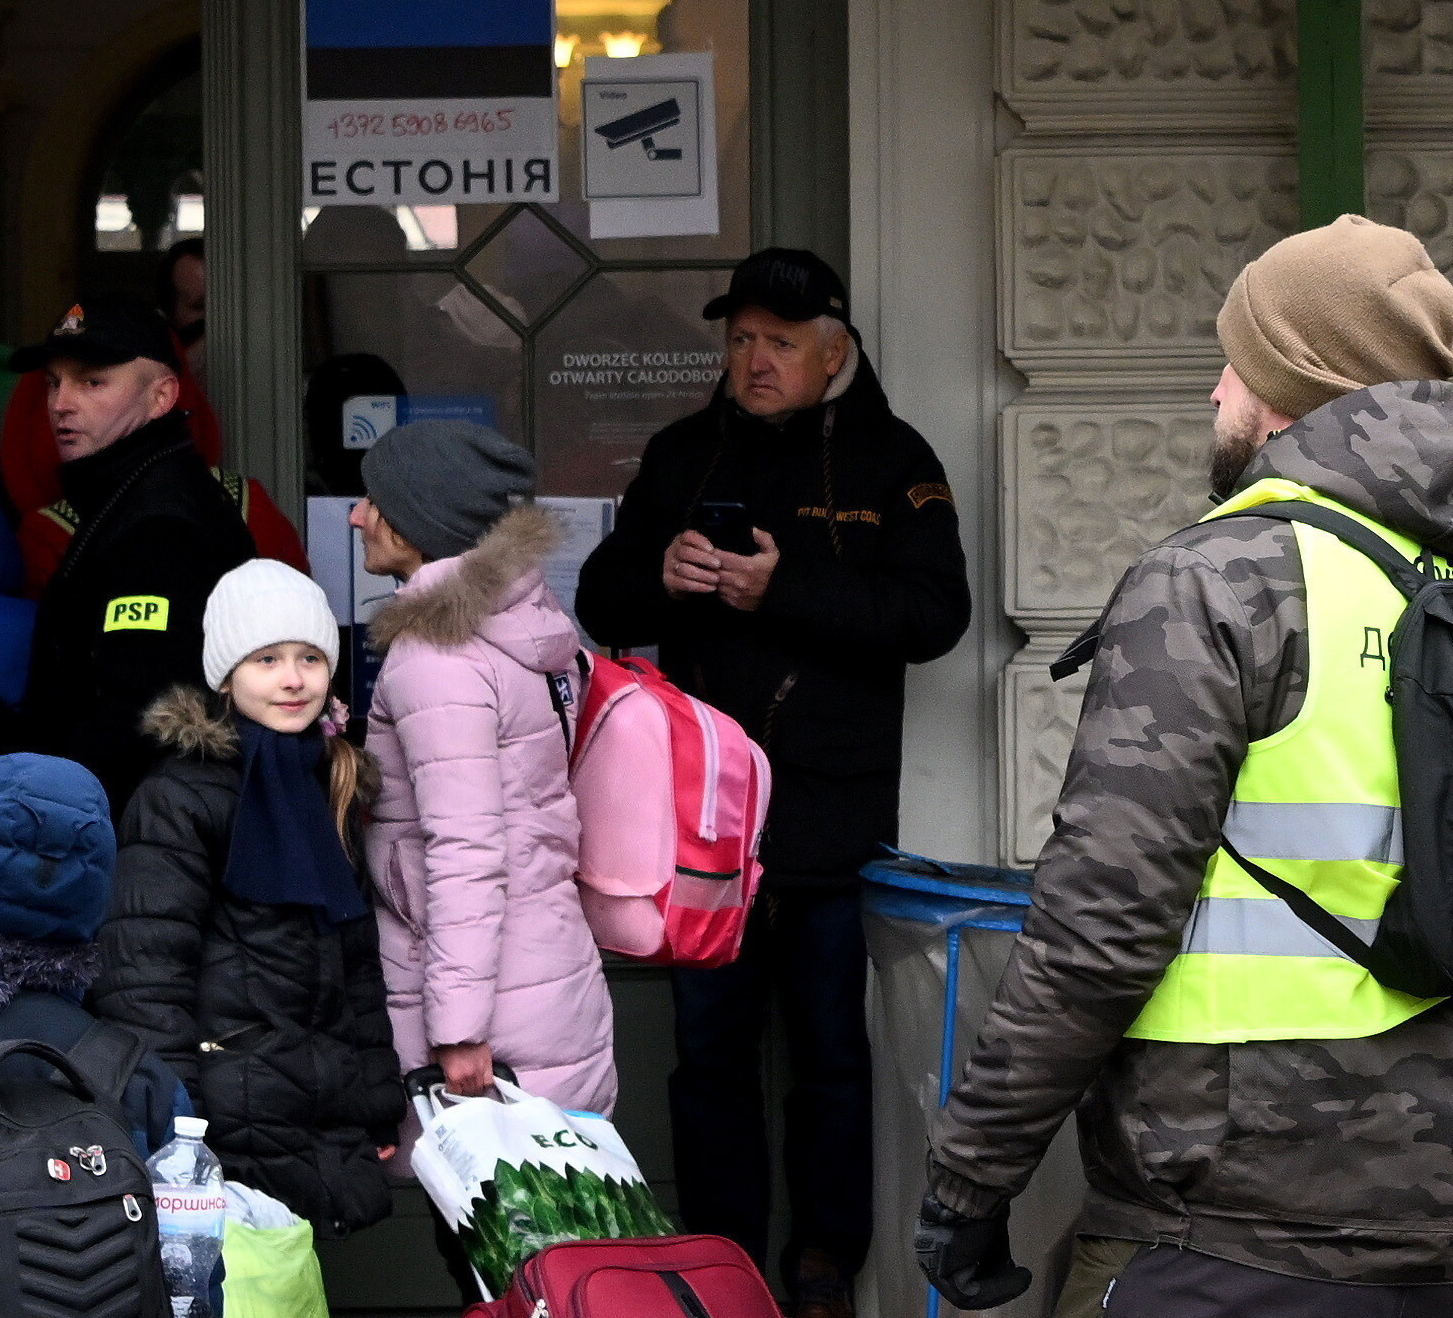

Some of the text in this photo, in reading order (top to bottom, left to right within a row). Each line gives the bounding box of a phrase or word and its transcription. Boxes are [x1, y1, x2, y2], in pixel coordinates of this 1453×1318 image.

[310, 157, 552, 197] ЕСТОНІЯ
[562, 351, 725, 368] DWORZEC KOLEJOWY
[549, 370, 623, 385] OTWARTY
[113, 602, 159, 623] PSP
[530, 1129, 599, 1151] ECO
